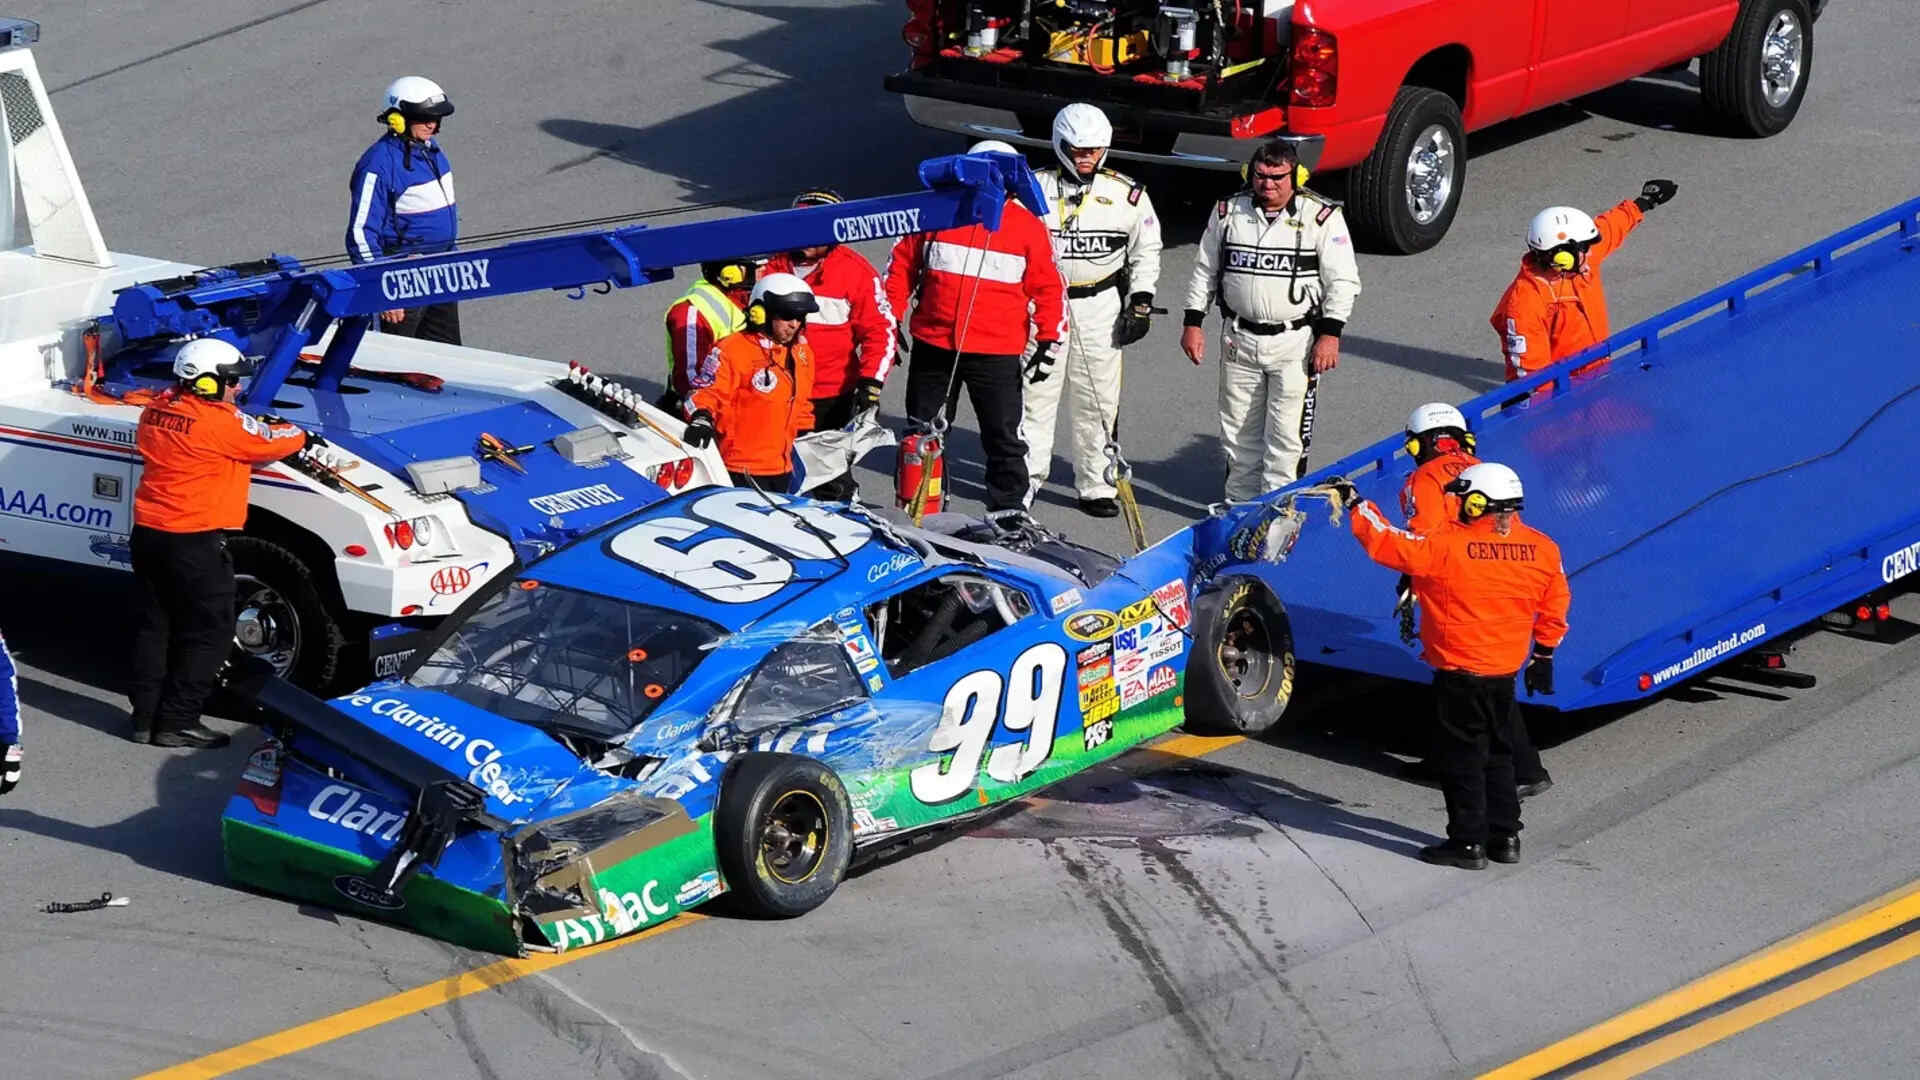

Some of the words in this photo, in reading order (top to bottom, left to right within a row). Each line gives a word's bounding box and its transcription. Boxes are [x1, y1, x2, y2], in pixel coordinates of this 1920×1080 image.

[833, 208, 920, 242] CENTURY
[1057, 237, 1112, 253] ICIAL
[382, 258, 491, 301] CENTURY
[528, 484, 624, 516] CENTURY
[1467, 542, 1536, 562] CENTURY
[434, 567, 467, 593] AAA
[1150, 640, 1182, 660] TISSOT
[1653, 623, 1766, 684] www.millerind.com
[909, 641, 1068, 804] 99
[371, 699, 467, 752] Claritin
[465, 739, 524, 807] Clear
